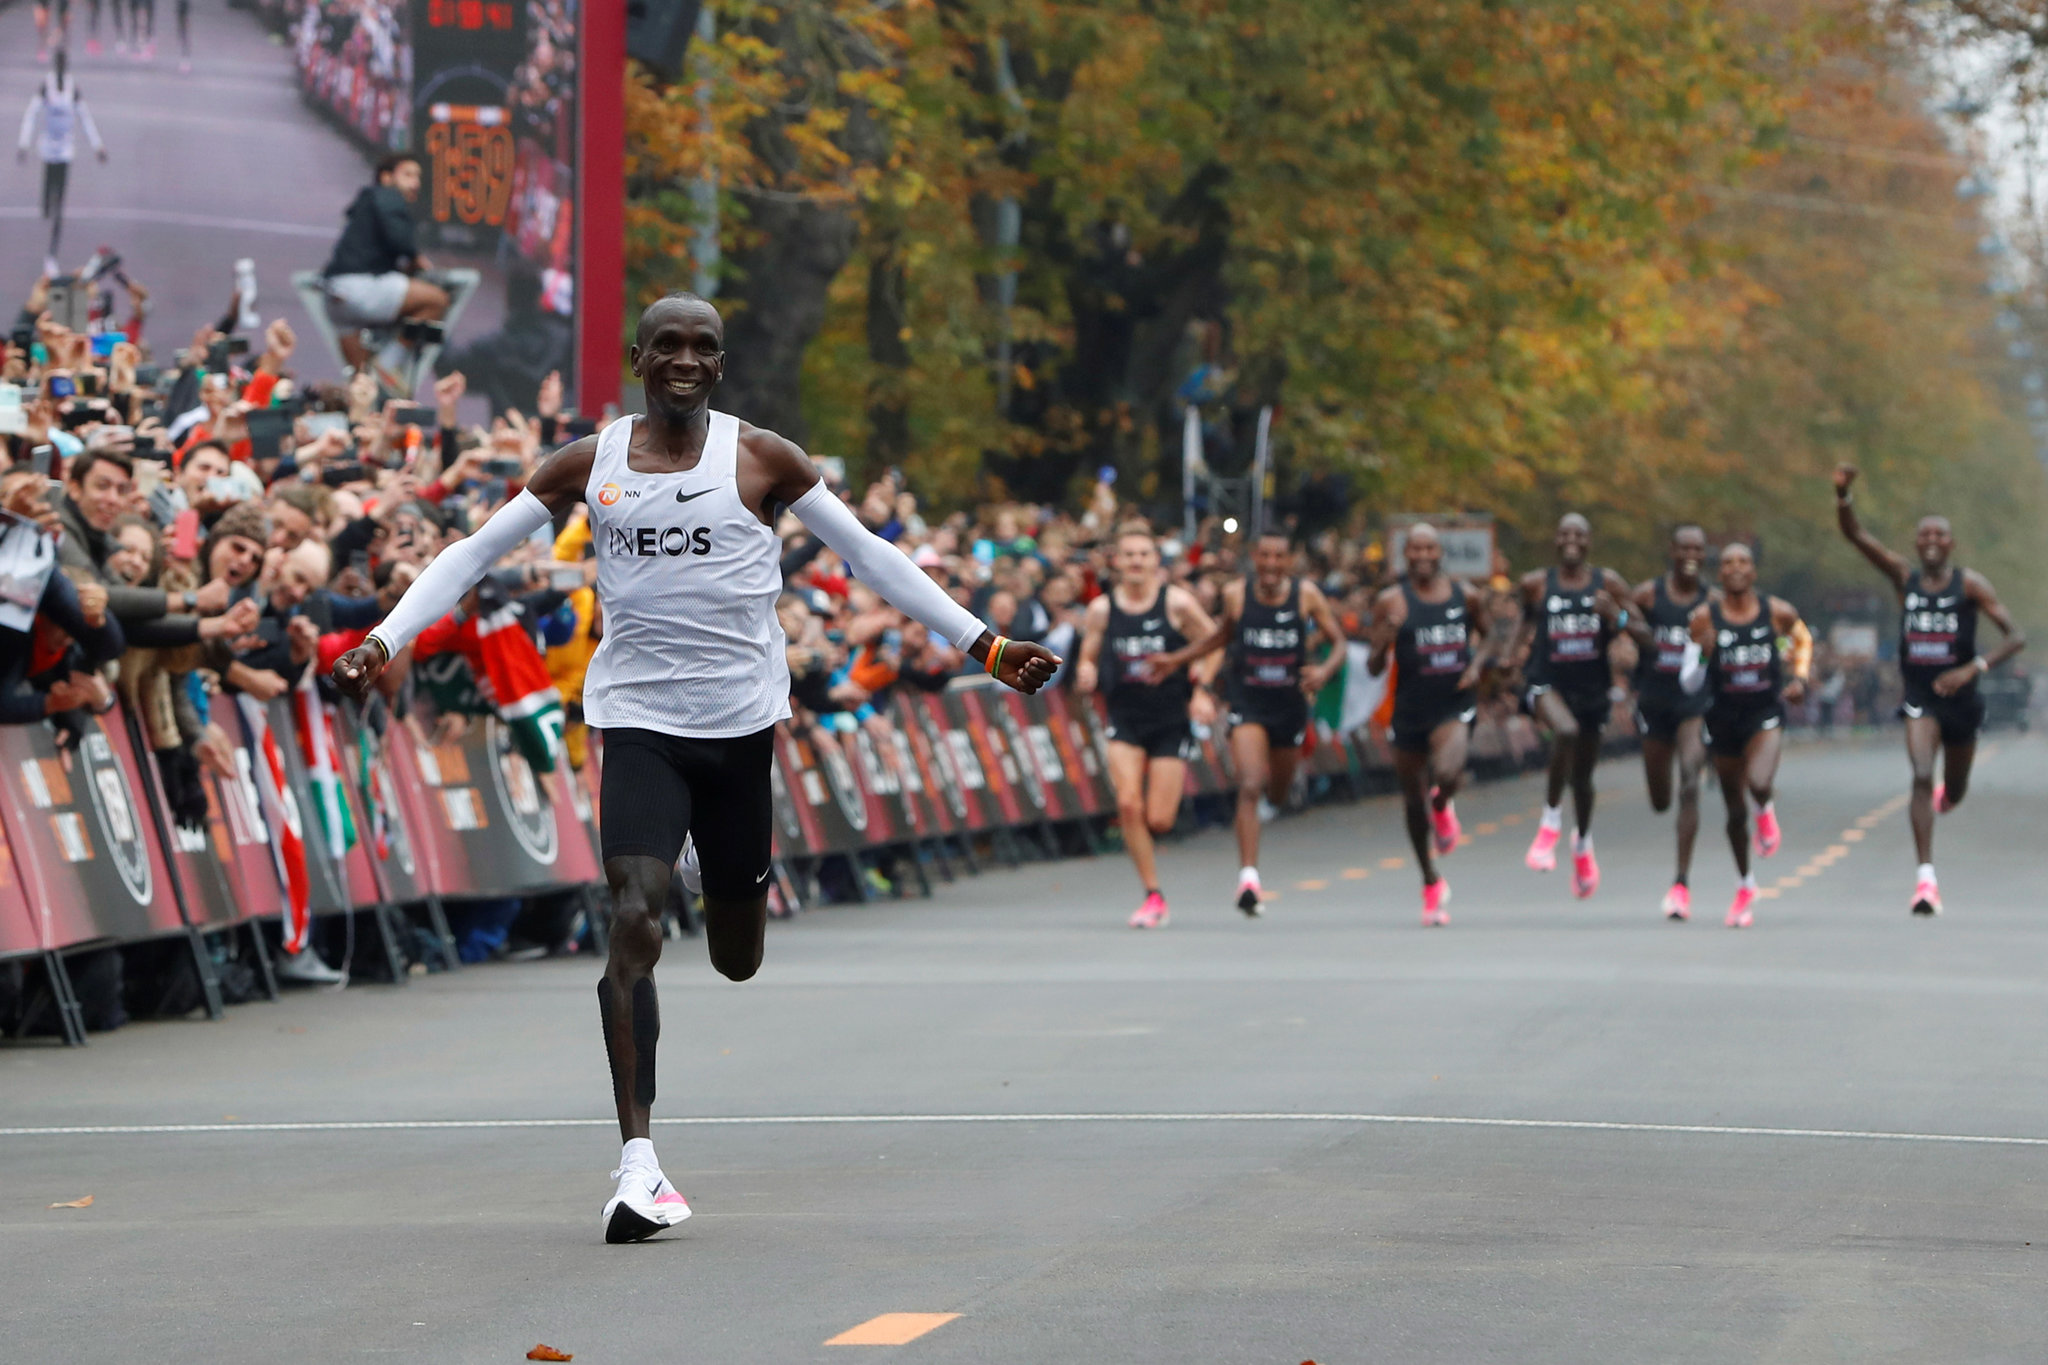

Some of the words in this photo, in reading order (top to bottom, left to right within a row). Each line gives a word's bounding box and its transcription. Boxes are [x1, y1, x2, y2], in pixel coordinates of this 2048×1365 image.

[624, 490, 641, 498] NN
[607, 526, 712, 557] INEOS
[1904, 611, 1958, 633] INEOS
